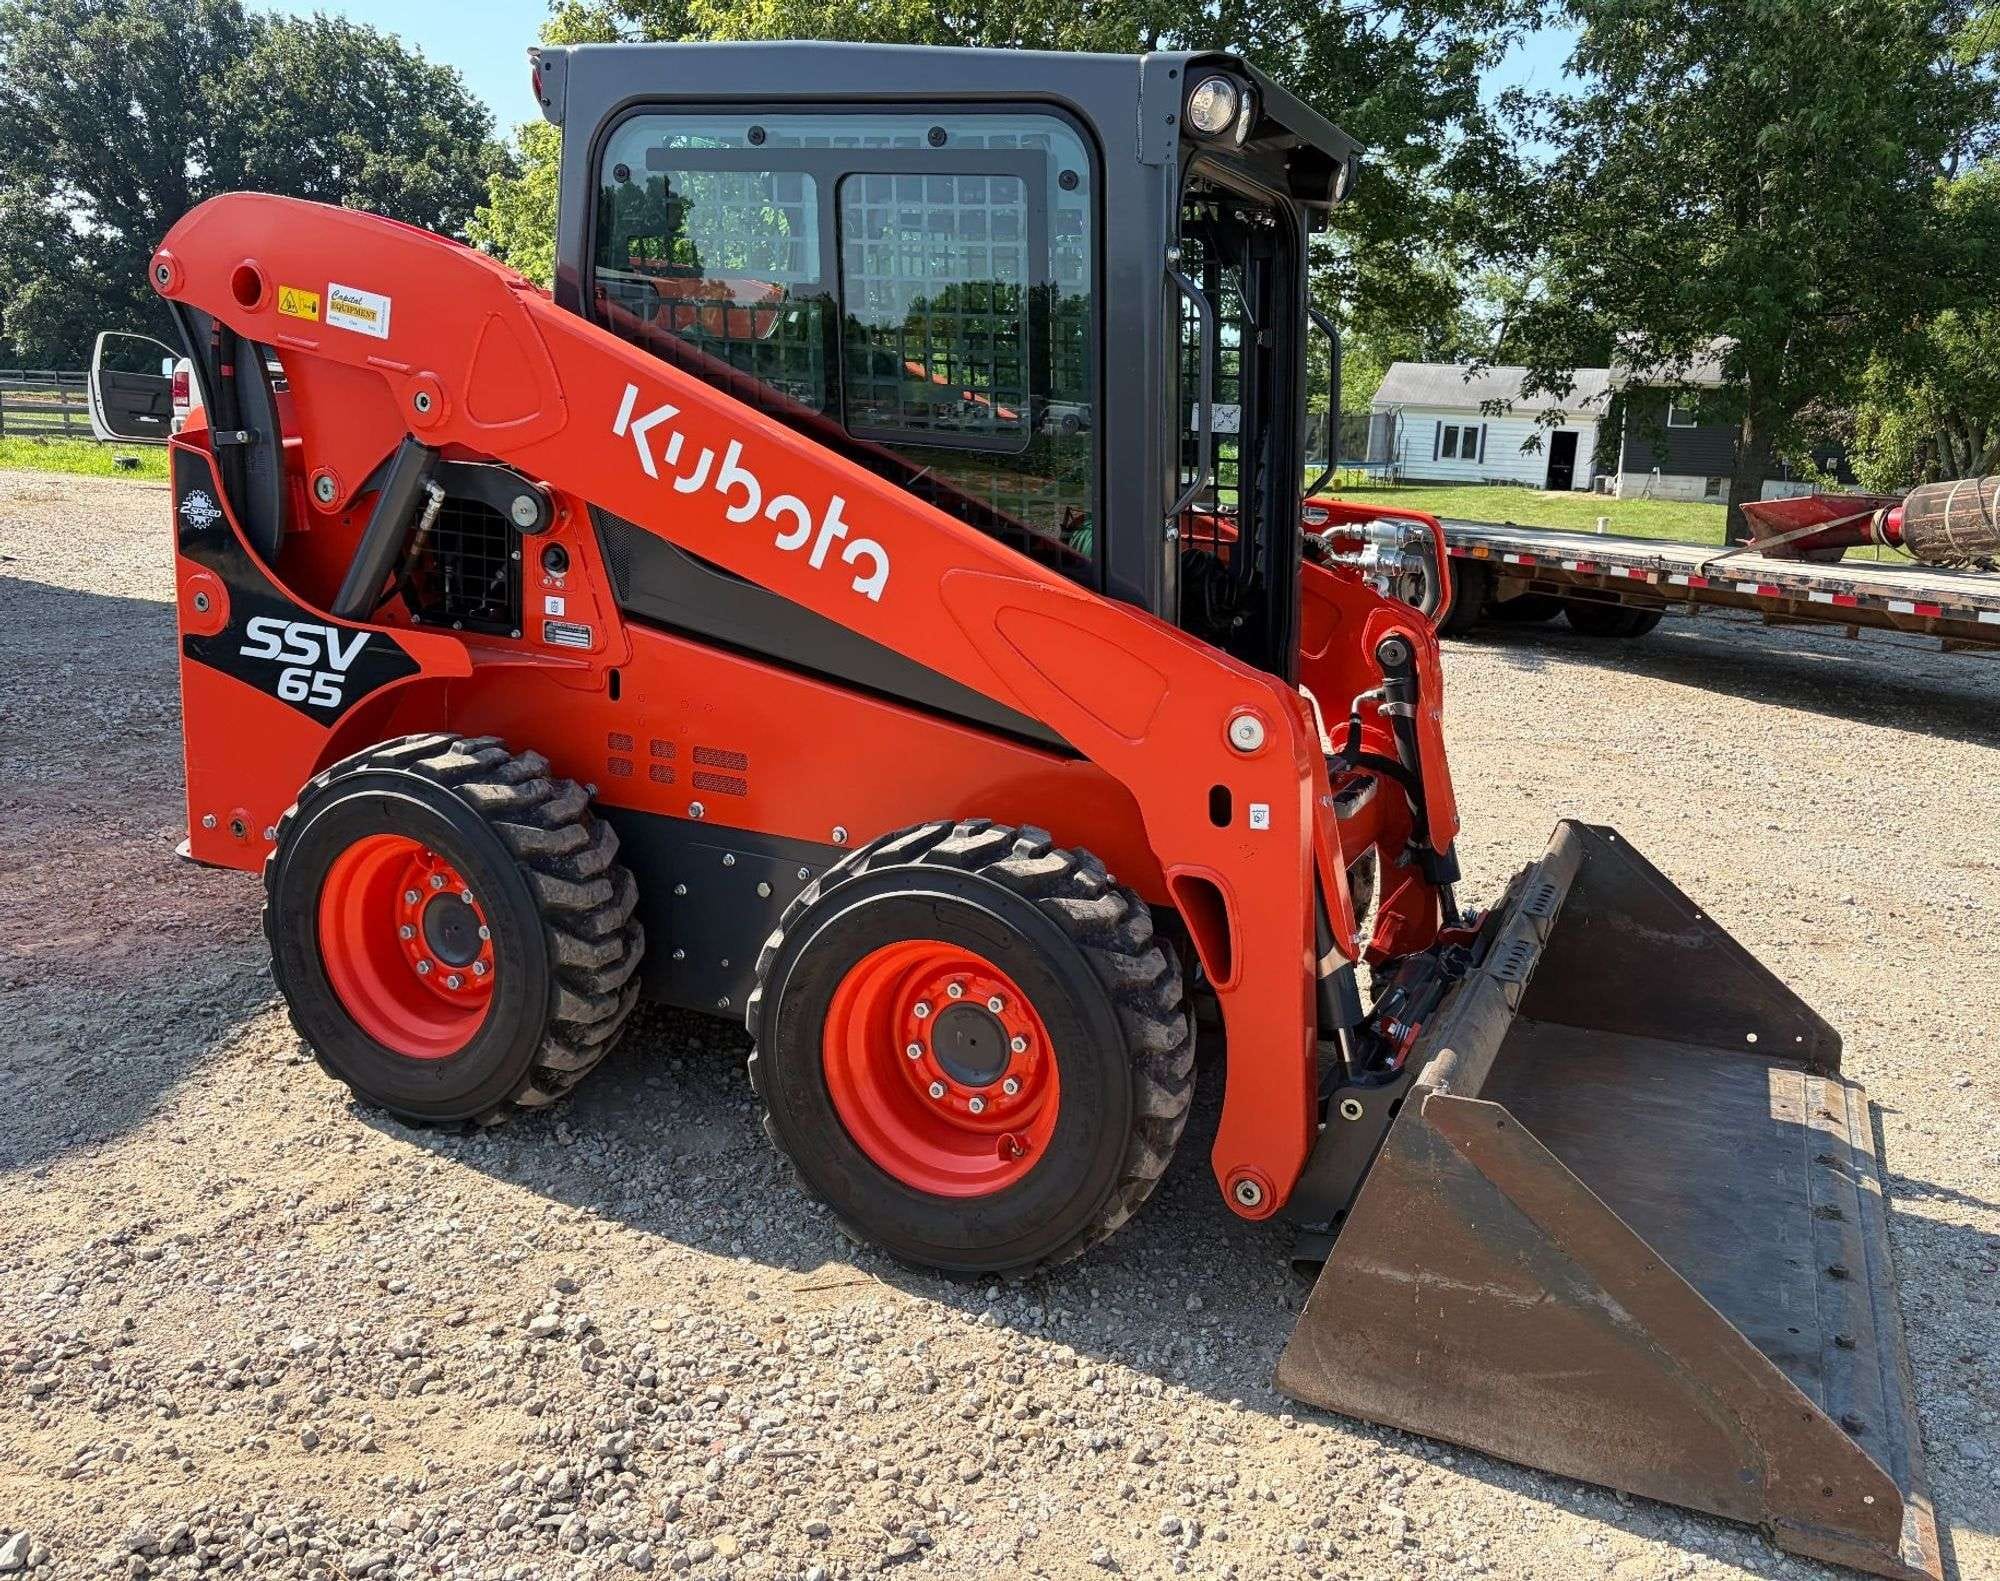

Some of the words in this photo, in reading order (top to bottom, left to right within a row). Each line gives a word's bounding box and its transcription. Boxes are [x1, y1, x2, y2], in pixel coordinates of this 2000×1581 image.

[330, 301, 377, 321] EQUIPMENT
[331, 289, 363, 305] Capital
[612, 383, 890, 602] Kubota
[180, 501, 192, 514] 2
[191, 506, 222, 518] SPEED
[240, 616, 371, 671] SSV
[277, 667, 346, 708] 65
